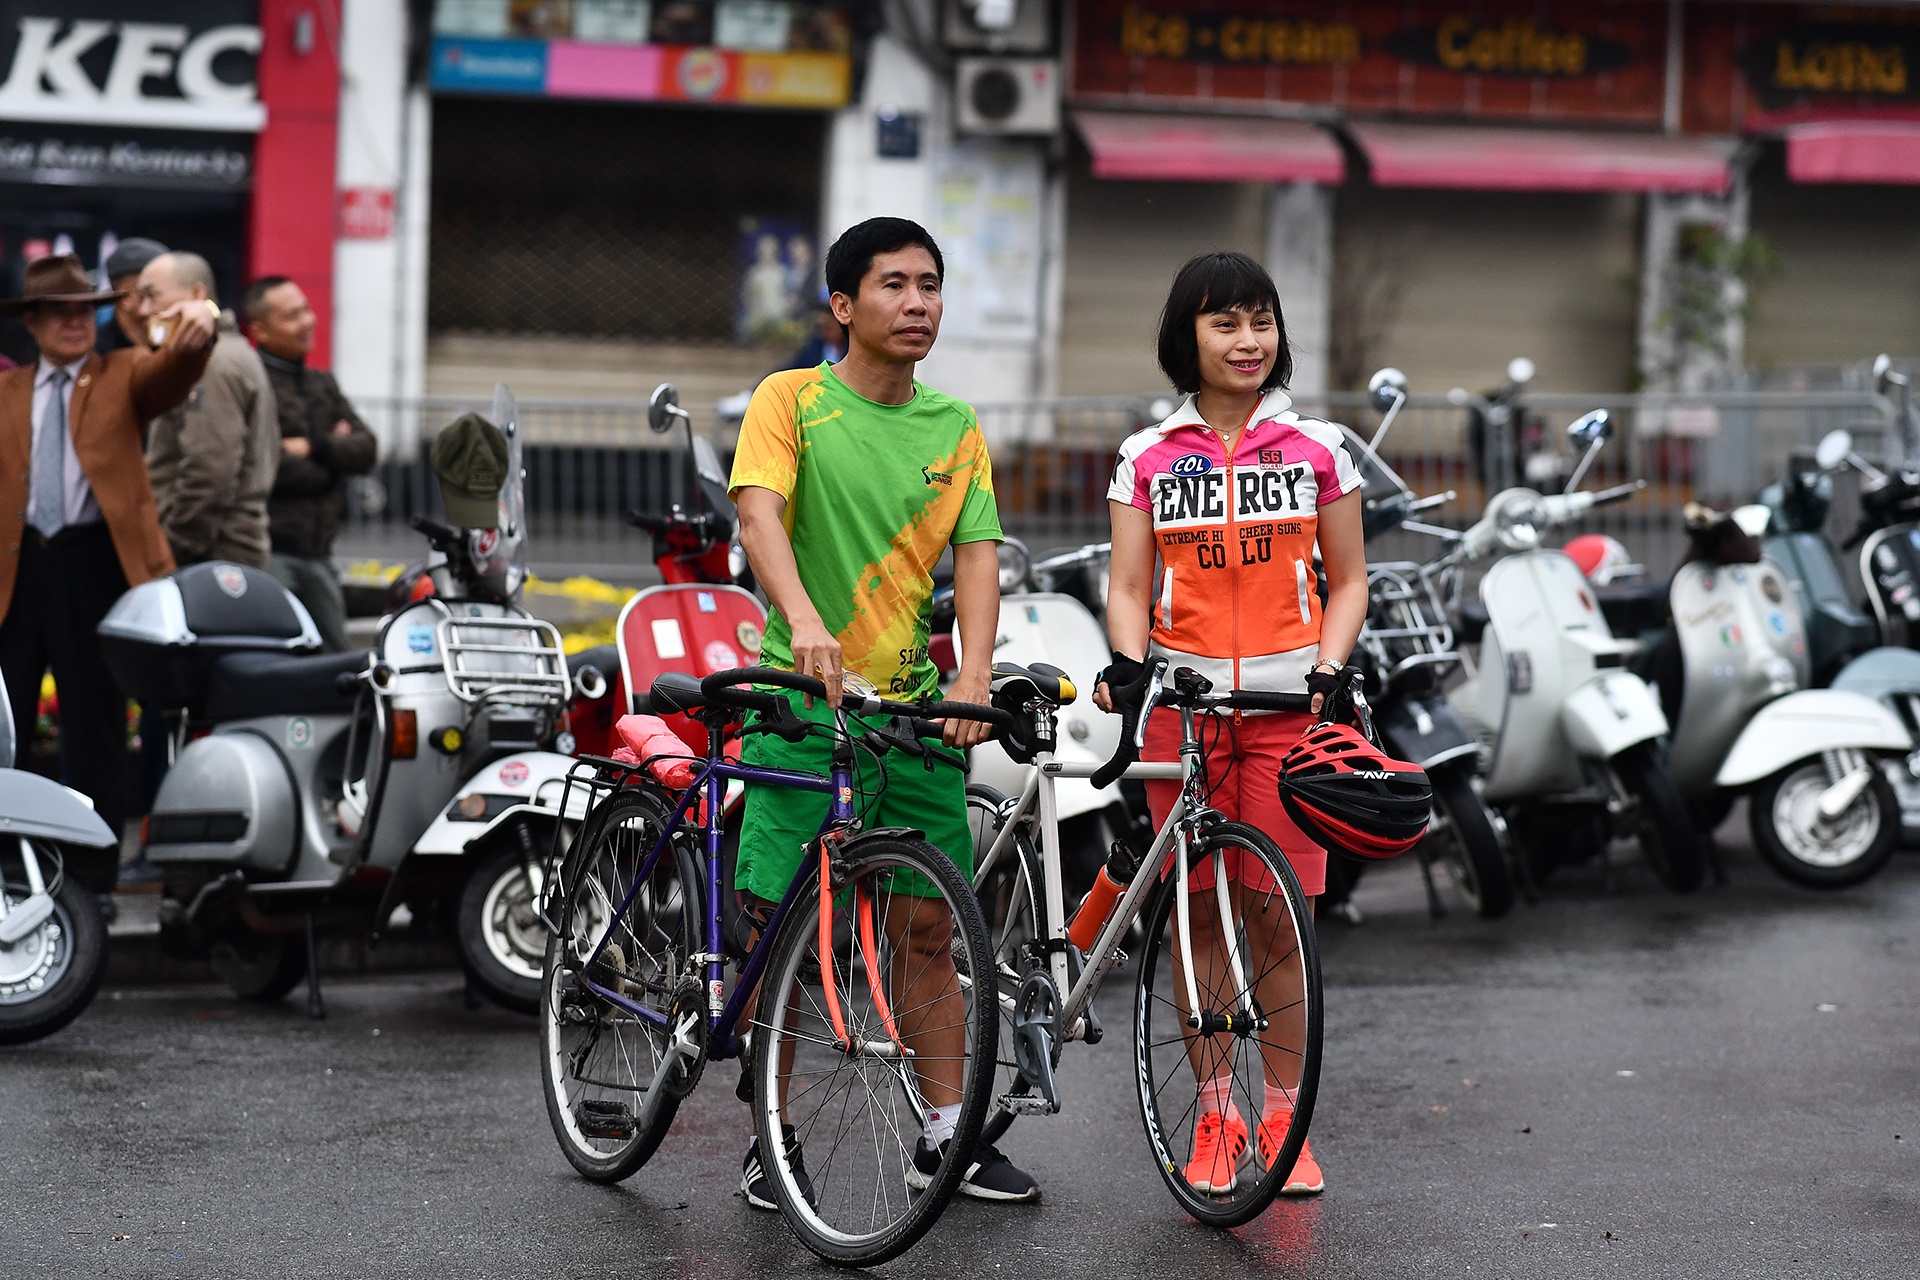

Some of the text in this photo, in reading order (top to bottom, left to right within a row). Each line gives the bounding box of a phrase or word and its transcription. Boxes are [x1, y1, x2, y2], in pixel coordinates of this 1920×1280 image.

[1436, 15, 1587, 75] Coffee
[0, 16, 263, 102] KFC
[1174, 456, 1205, 472] COL
[1262, 451, 1281, 462] 56
[1162, 530, 1209, 546] EXTREME
[1212, 530, 1224, 542] HI
[1239, 523, 1274, 539] CHEER
[888, 675, 922, 694] RUN
